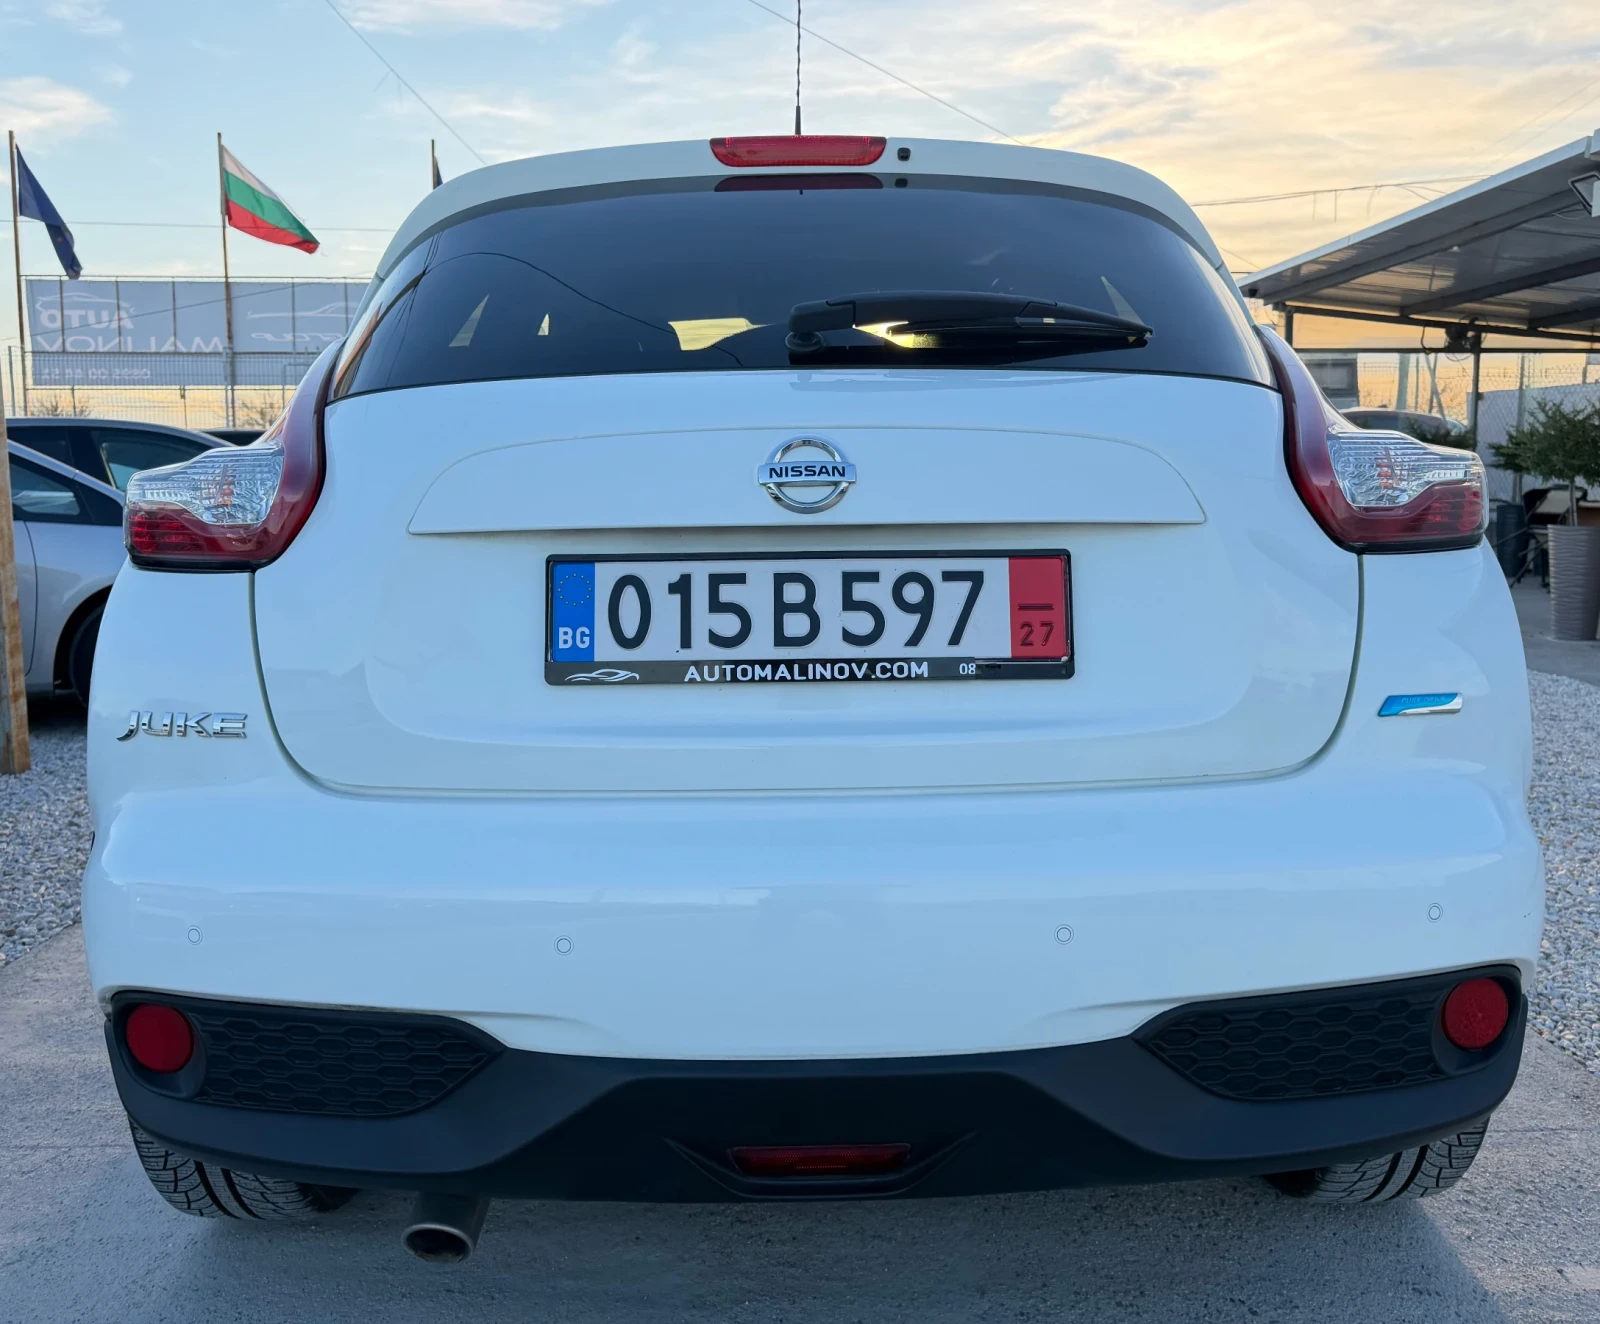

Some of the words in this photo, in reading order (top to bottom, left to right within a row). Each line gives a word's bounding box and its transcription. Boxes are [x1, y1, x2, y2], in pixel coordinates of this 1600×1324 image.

[769, 465, 846, 479] NISSAN
[558, 626, 591, 649] BG
[1019, 622, 1055, 647] 27
[684, 661, 930, 682] AUTOMALINOV.COM
[959, 663, 976, 675] 08
[116, 711, 248, 742] JUKE
